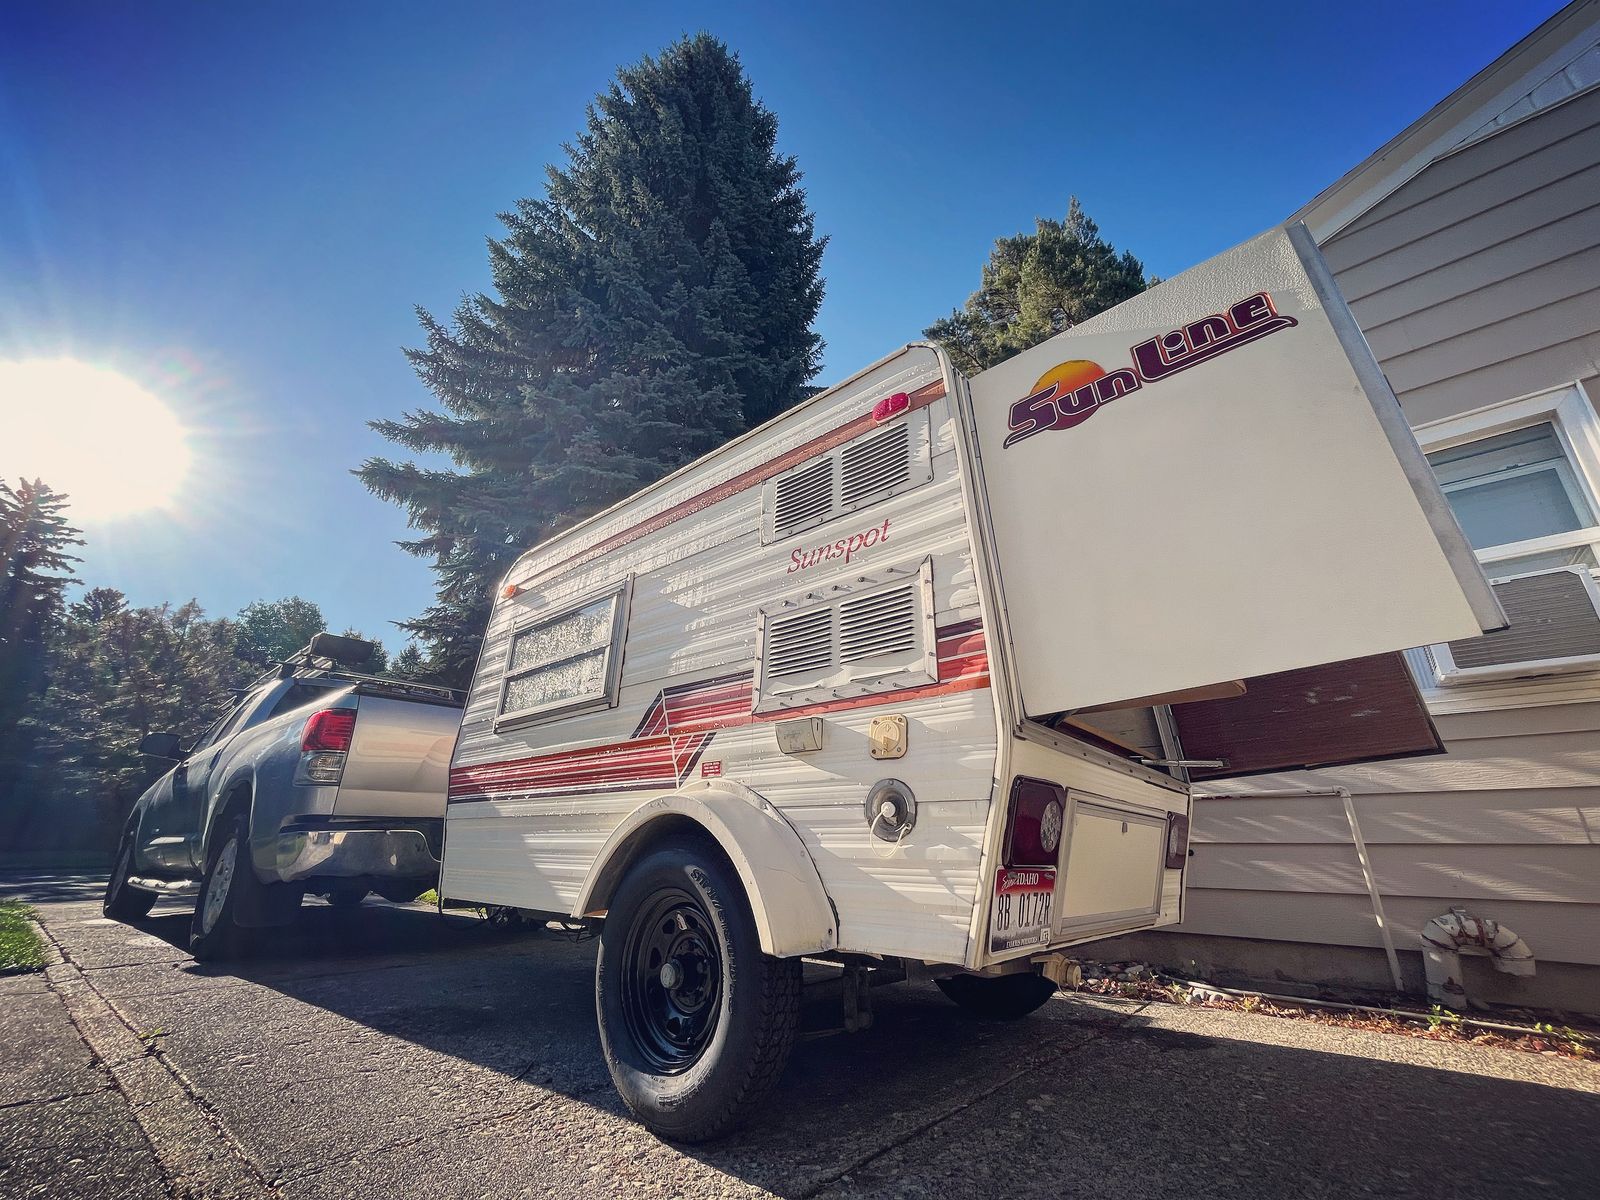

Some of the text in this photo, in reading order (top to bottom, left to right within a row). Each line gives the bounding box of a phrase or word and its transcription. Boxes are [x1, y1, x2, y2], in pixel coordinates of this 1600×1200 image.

[787, 518, 892, 574] Sunspot
[1017, 872, 1039, 885] IDAHO
[996, 893, 1011, 931] 8B
